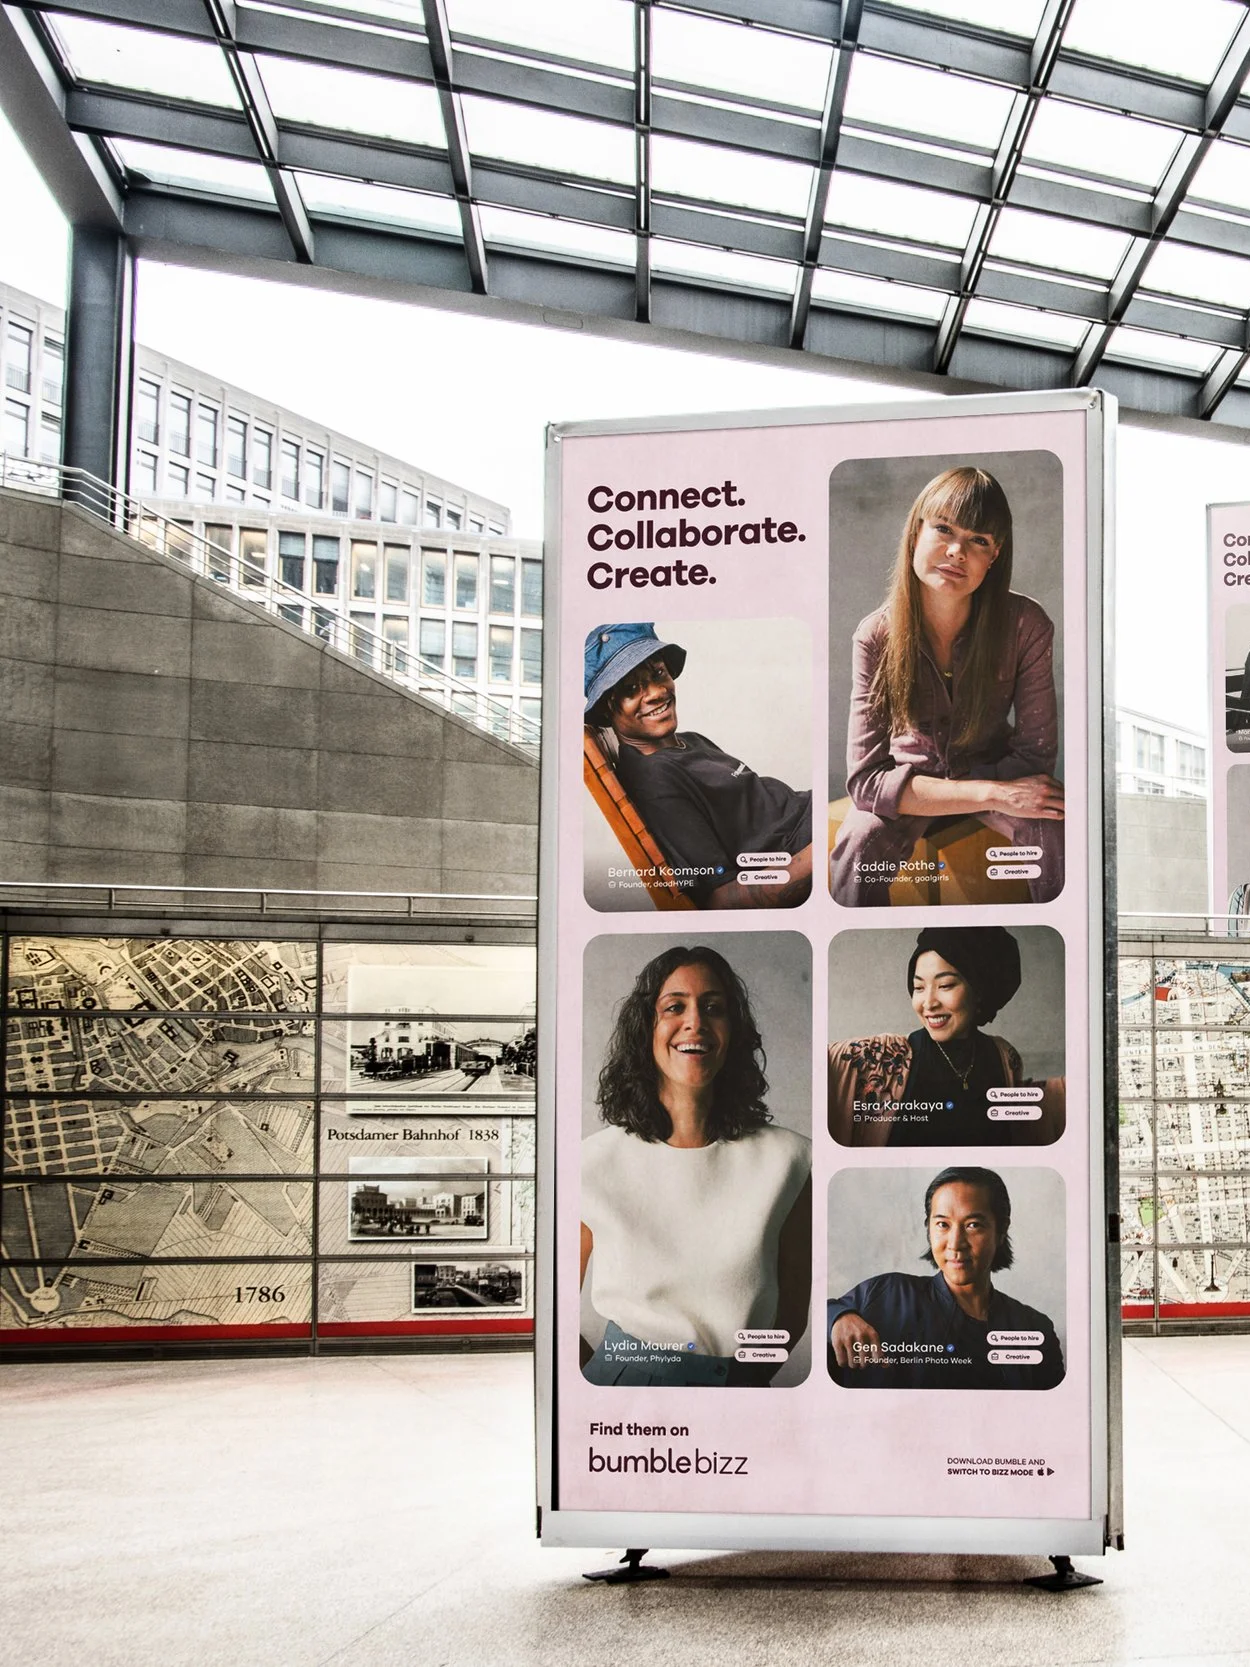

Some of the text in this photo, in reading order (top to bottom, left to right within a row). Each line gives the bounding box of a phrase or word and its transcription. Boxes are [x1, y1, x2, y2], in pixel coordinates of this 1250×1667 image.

[588, 480, 746, 513] Connect.
[587, 517, 806, 552] Collaborate.
[587, 560, 717, 590] Create.
[749, 856, 768, 864] People
[608, 866, 715, 878] Bernard Koomson
[853, 860, 936, 873] Kaddie Rothe
[618, 879, 694, 890] Founder, deadHYPE
[864, 874, 949, 884] Co-Founder, goalgirls
[854, 1100, 944, 1113] Esra Karakaya
[864, 1114, 900, 1122] Producer
[910, 1114, 928, 1122] Host
[327, 1128, 499, 1141] Potsdamer Bahnhof 1838
[235, 1284, 286, 1304] 1786
[604, 1340, 684, 1353] Lydia Maurer
[852, 1341, 944, 1353] Gen Sadakane
[615, 1354, 682, 1364] Founder, Phylyda
[864, 1356, 972, 1366] Founder, Berlin Photo Week
[590, 1422, 689, 1436] Find them on
[947, 1457, 1046, 1466] DOWNLOAD BUMBLE AND
[947, 1468, 978, 1476] SWITCH
[979, 1468, 990, 1476] TO
